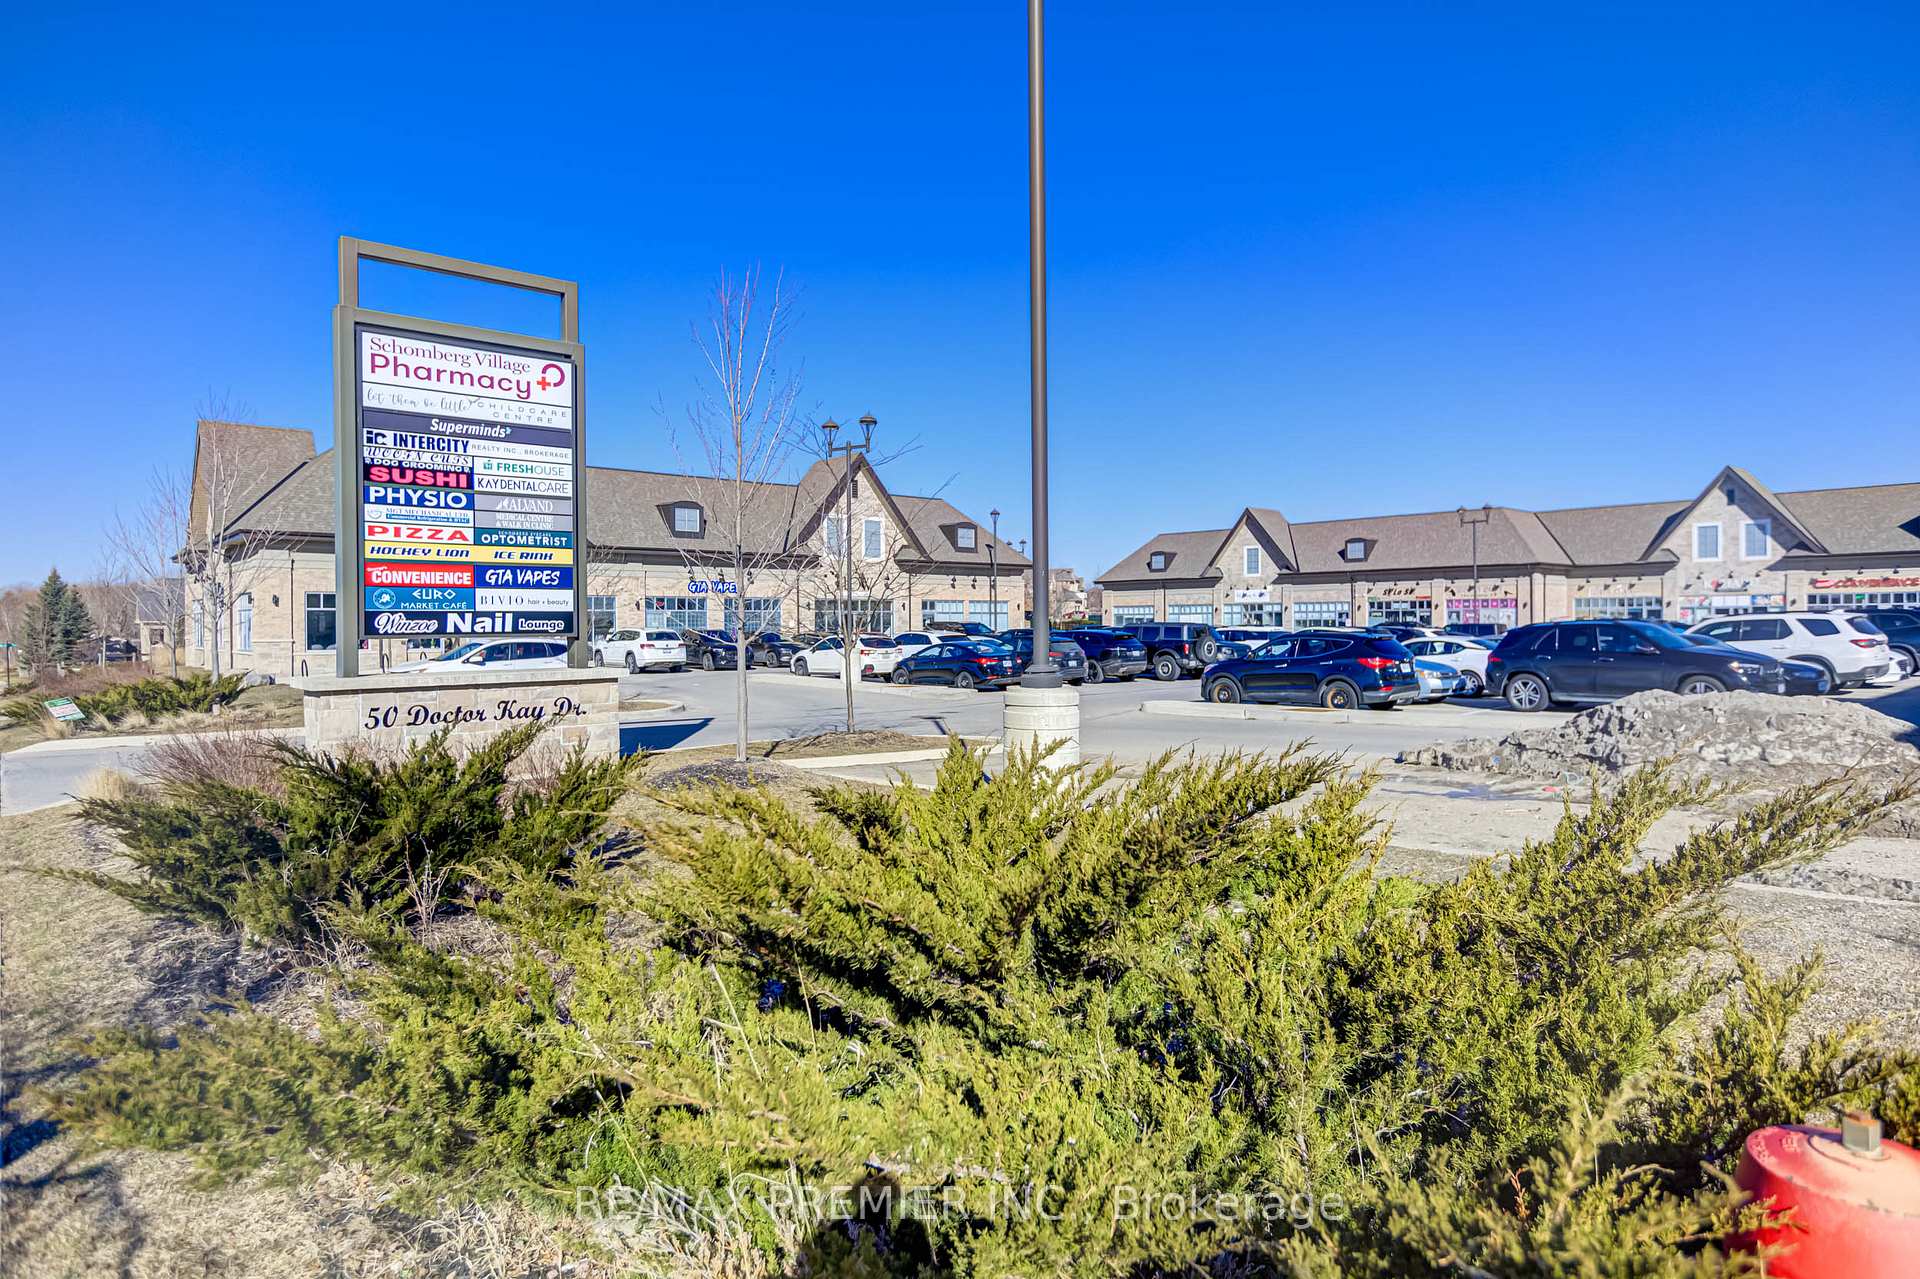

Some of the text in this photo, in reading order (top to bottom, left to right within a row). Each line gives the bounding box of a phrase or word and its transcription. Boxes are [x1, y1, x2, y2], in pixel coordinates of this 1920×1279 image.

[370, 337, 531, 374] Schomberg Village
[370, 353, 531, 399] Pharmacy
[477, 402, 567, 418] CHILDCARE
[493, 412, 553, 424] CENTRE
[430, 418, 506, 438] Superminds
[393, 432, 469, 454] INTERCITY
[471, 443, 500, 452] REALTY
[524, 450, 569, 459] BROKERAGE
[374, 458, 463, 472] DOG GROOMING
[369, 466, 467, 488] SUSHI
[370, 486, 467, 508] PHYSIO
[368, 525, 470, 541] PIZZA
[481, 534, 567, 546] OPTOMETRIST
[370, 546, 432, 556] HOCKEY
[494, 551, 516, 559] ICE
[519, 552, 553, 560] RINK
[372, 571, 471, 585] CONVENIENCE
[485, 569, 560, 586] GTA VAPES
[412, 588, 456, 599] EURO
[688, 581, 708, 593] GTA
[481, 595, 523, 605] BIVIO
[547, 598, 569, 606] beauty
[446, 612, 513, 633] Nail
[519, 619, 564, 632] Lounge
[365, 697, 587, 730] 50 Doctor Kay Dr.
